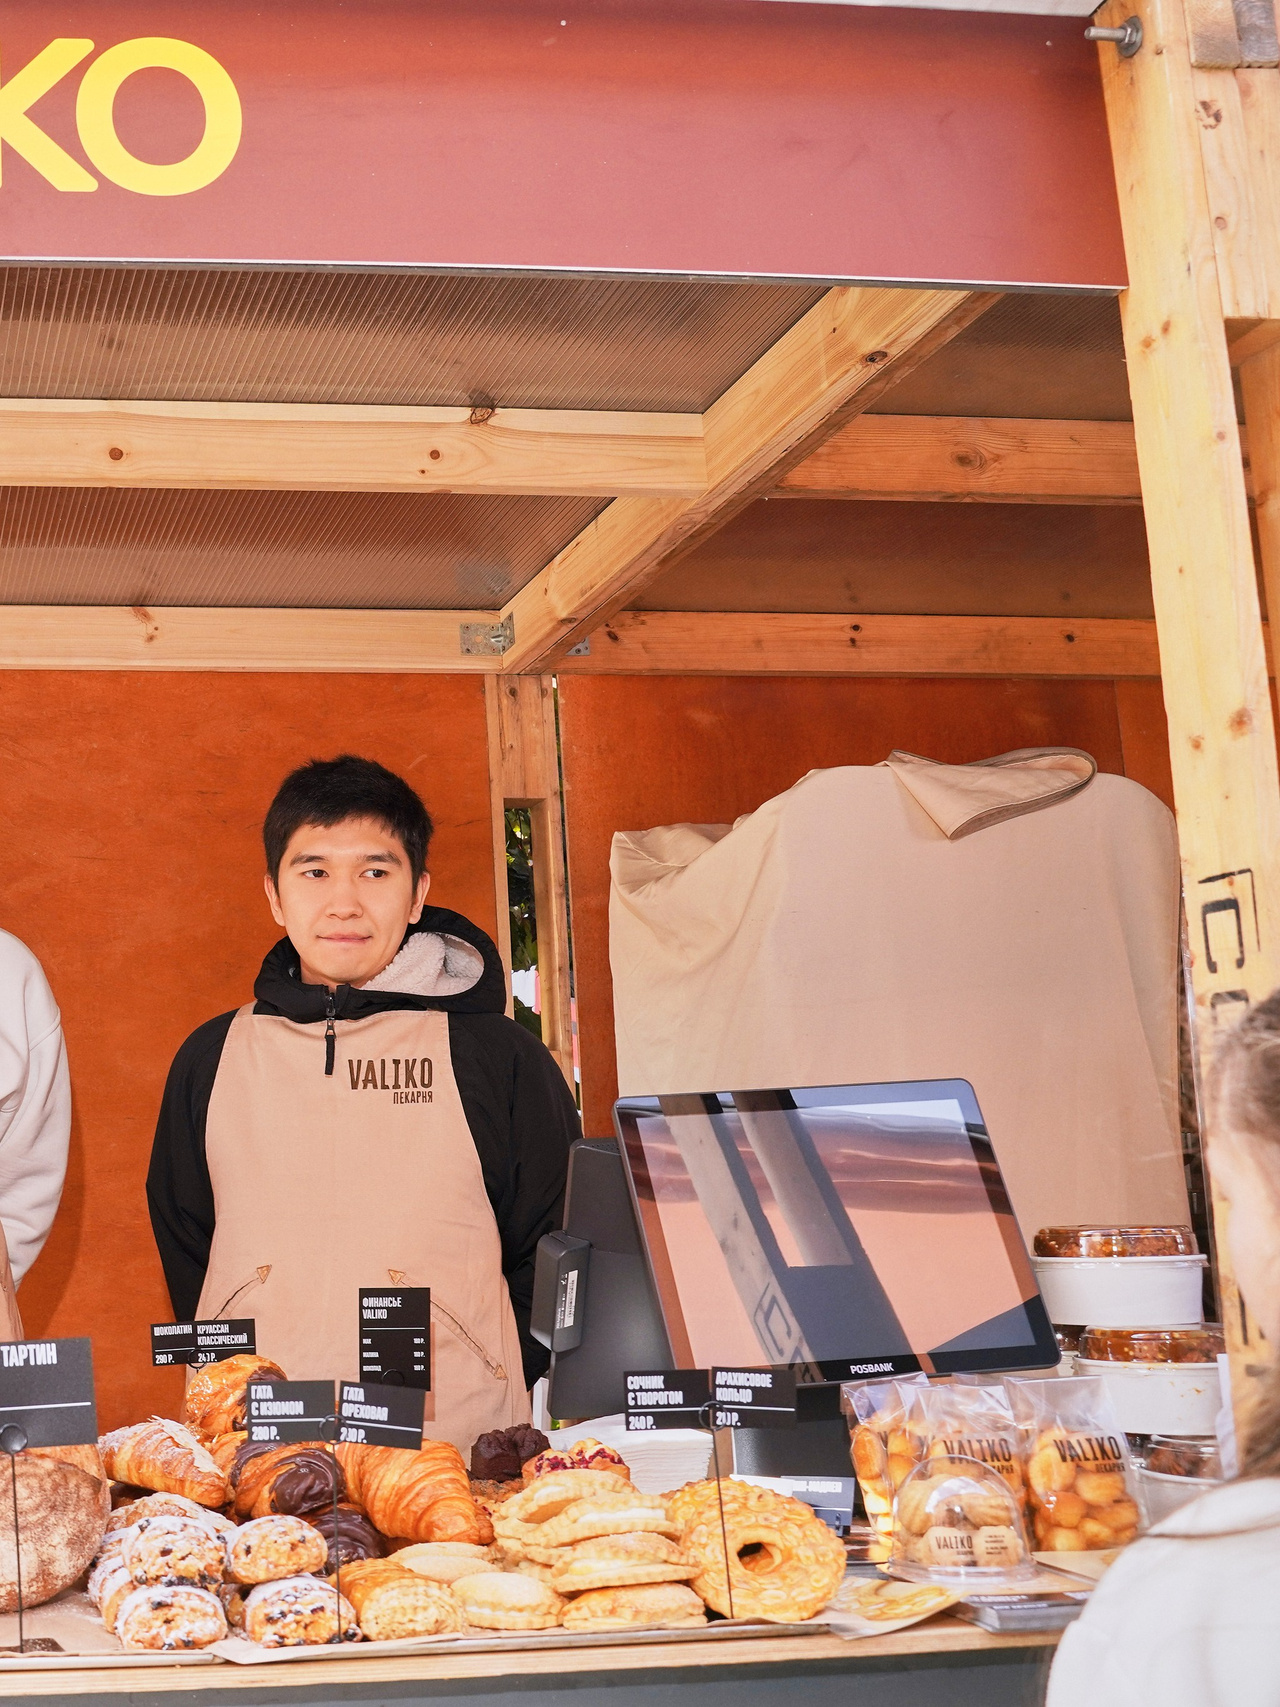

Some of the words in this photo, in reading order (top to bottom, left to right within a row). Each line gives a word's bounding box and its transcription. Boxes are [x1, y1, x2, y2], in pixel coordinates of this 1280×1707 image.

[348, 1057, 433, 1090] VALIKO
[393, 1091, 433, 1104] ПЕКАРНЯ
[362, 1297, 402, 1308] ФИНАНСЬЕ
[362, 1308, 388, 1320] VALIKO
[154, 1324, 193, 1336] ШОКОЛАТИН
[197, 1324, 229, 1334] КРУАССАН
[197, 1332, 248, 1346] КЛАССИЧЕСКИЙ
[0, 1342, 58, 1367] ТАРТИН
[850, 1362, 895, 1374] POSBANK
[627, 1375, 665, 1390] СОЧНИК
[715, 1371, 773, 1388] АРАХИСОВОЕ
[250, 1385, 274, 1400] ГАТА
[342, 1386, 365, 1402] ГАТА
[627, 1392, 635, 1406] С
[636, 1390, 684, 1405] ТВОРОГОМ
[716, 1388, 753, 1403] КОЛЬЦО
[251, 1401, 259, 1416] С
[260, 1401, 304, 1416] ИЗЮМОМ
[341, 1402, 389, 1422] ОРЕХОВАЯ
[943, 1438, 1012, 1465] VALIKO
[1053, 1436, 1122, 1462] VALIKO
[935, 1535, 973, 1550] VALIKO
